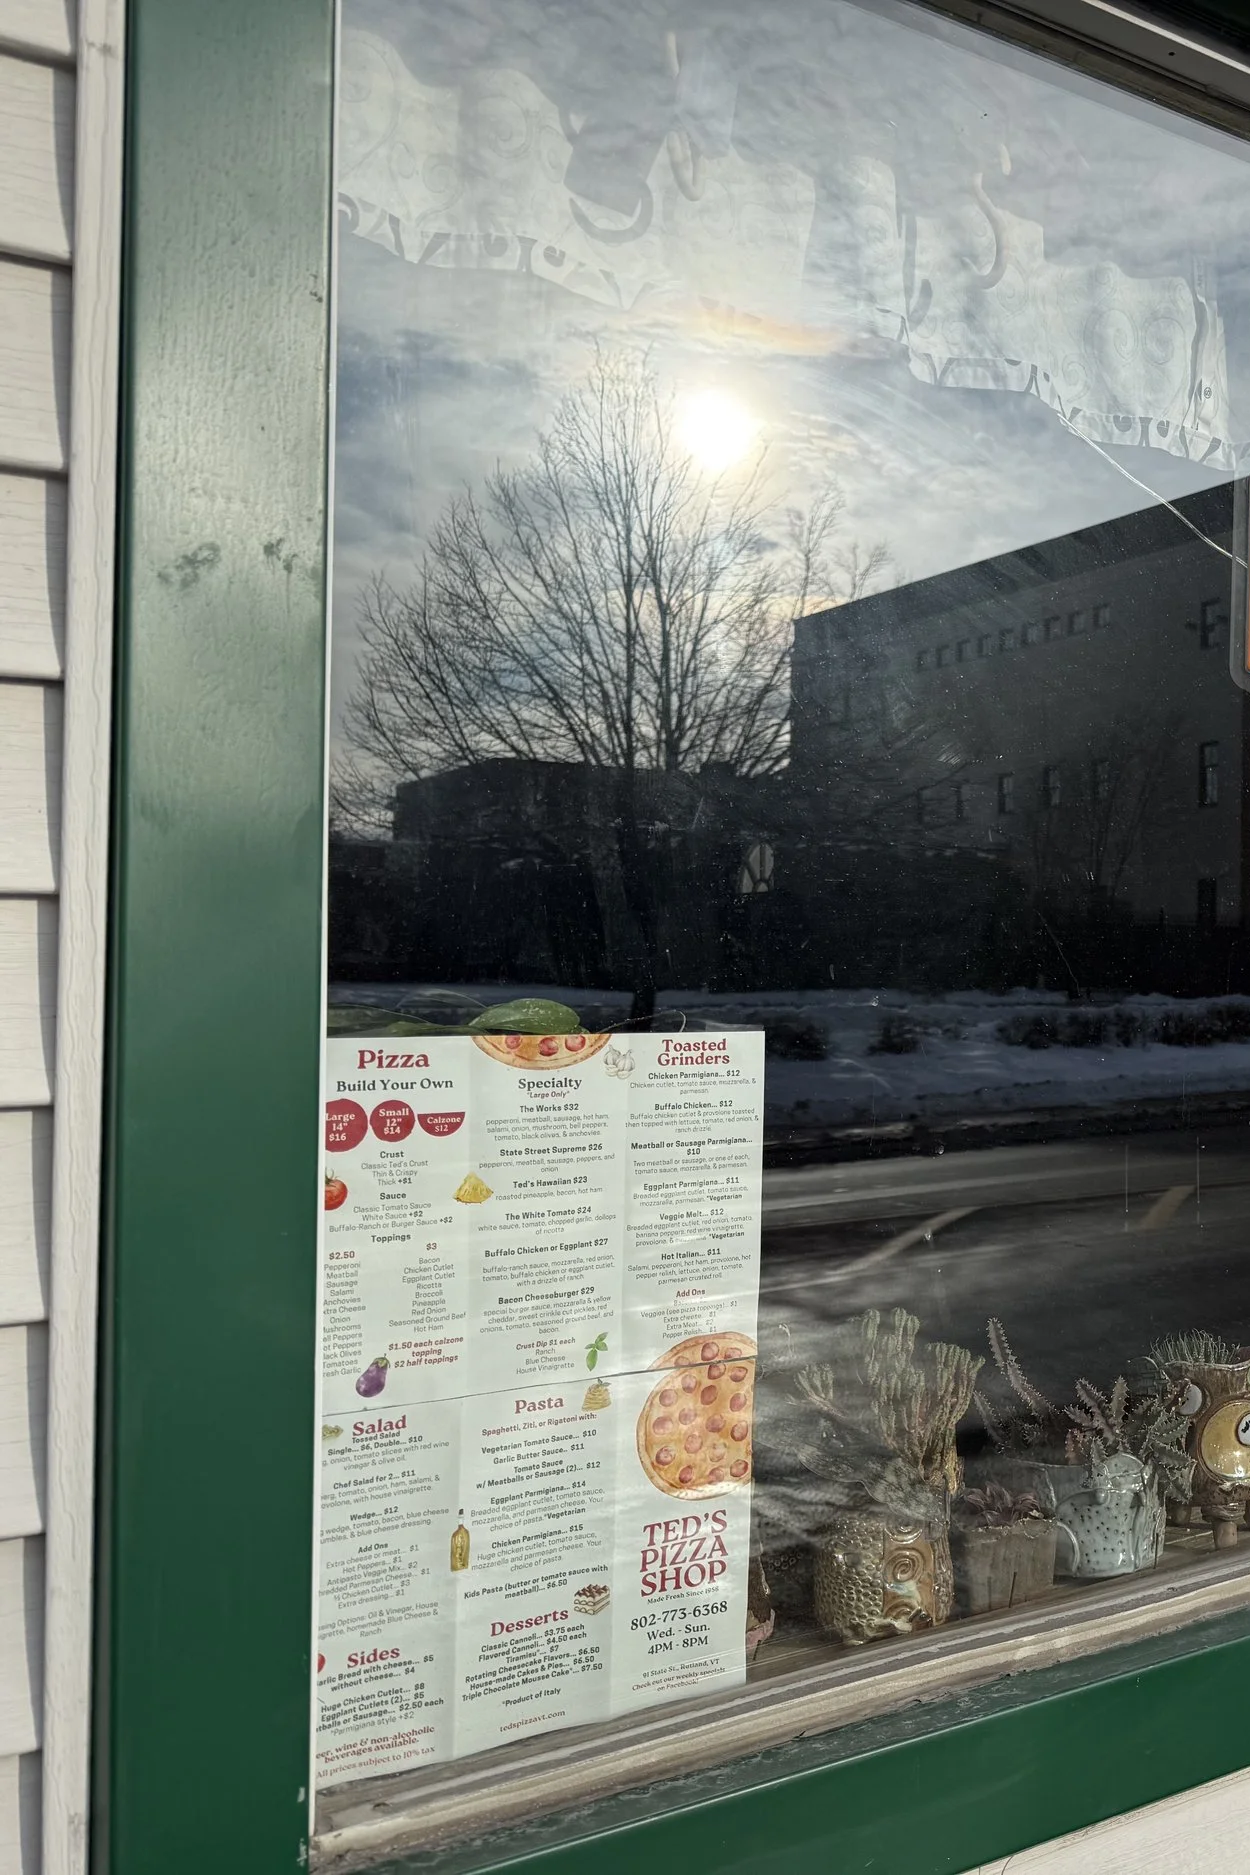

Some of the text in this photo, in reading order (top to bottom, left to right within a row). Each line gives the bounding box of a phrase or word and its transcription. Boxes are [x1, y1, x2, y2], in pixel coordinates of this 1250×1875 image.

[662, 1038, 726, 1052] Toasted
[357, 1050, 430, 1069] Pizza
[657, 1053, 730, 1066] Grinders
[337, 1079, 453, 1092] Build Your Own
[518, 1078, 582, 1091] Specialty
[326, 1113, 355, 1122] Large
[379, 1108, 409, 1116] Small
[329, 1133, 346, 1141] $16
[631, 1142, 665, 1150] Meatball
[536, 1178, 571, 1187] Hawaiian
[643, 1182, 677, 1192] Eggplant
[522, 1211, 545, 1219] White
[371, 1234, 411, 1243] Toppings
[329, 1251, 355, 1260] $2.50
[485, 1248, 515, 1258] Buffalo
[517, 1246, 548, 1255] Chicken
[560, 1241, 592, 1251] Eggplant
[525, 1290, 579, 1302] Cheeseburger
[388, 1337, 463, 1351] $1.50 each calzone
[516, 1342, 535, 1350] Crust
[412, 1349, 442, 1358] topping
[394, 1355, 458, 1368] $2 half toppings
[515, 1398, 564, 1414] Pasta
[352, 1415, 407, 1436] Salad
[482, 1424, 521, 1437] Spaghetti,
[523, 1422, 537, 1430] Ziti,
[548, 1415, 577, 1426] Rigatoni
[352, 1431, 400, 1444] Tossed Salad
[408, 1436, 423, 1444] $10
[481, 1443, 522, 1454] Vegetarian
[524, 1438, 550, 1447] Tomato
[583, 1430, 597, 1438] $10
[493, 1456, 515, 1464] Garlic
[517, 1452, 540, 1461] Butter
[490, 1493, 523, 1505] Eggplant
[572, 1481, 586, 1489] $14
[384, 1506, 398, 1515] $12
[492, 1539, 521, 1549] Chicken
[569, 1524, 583, 1532] $15
[358, 1545, 372, 1554] Add
[640, 1536, 728, 1573] PIZZA
[641, 1561, 726, 1597] SHOP
[631, 1601, 727, 1631] 802-773-6368
[491, 1610, 568, 1637] Desserts
[481, 1641, 508, 1652] Classic
[544, 1628, 565, 1637] $3.75
[567, 1624, 585, 1632] each
[647, 1628, 675, 1641] Wed.
[685, 1624, 710, 1634] Sun.
[478, 1648, 510, 1662] Flavored
[546, 1636, 568, 1645] $4.50
[569, 1632, 587, 1640] each
[648, 1642, 672, 1655] 4PM
[682, 1636, 708, 1648] 8PM
[347, 1648, 400, 1669] Sides
[321, 1702, 342, 1713] Huge
[343, 1694, 376, 1706] Chicken
[414, 1683, 425, 1691] $8
[500, 1711, 565, 1732] tedspizzavt.com
